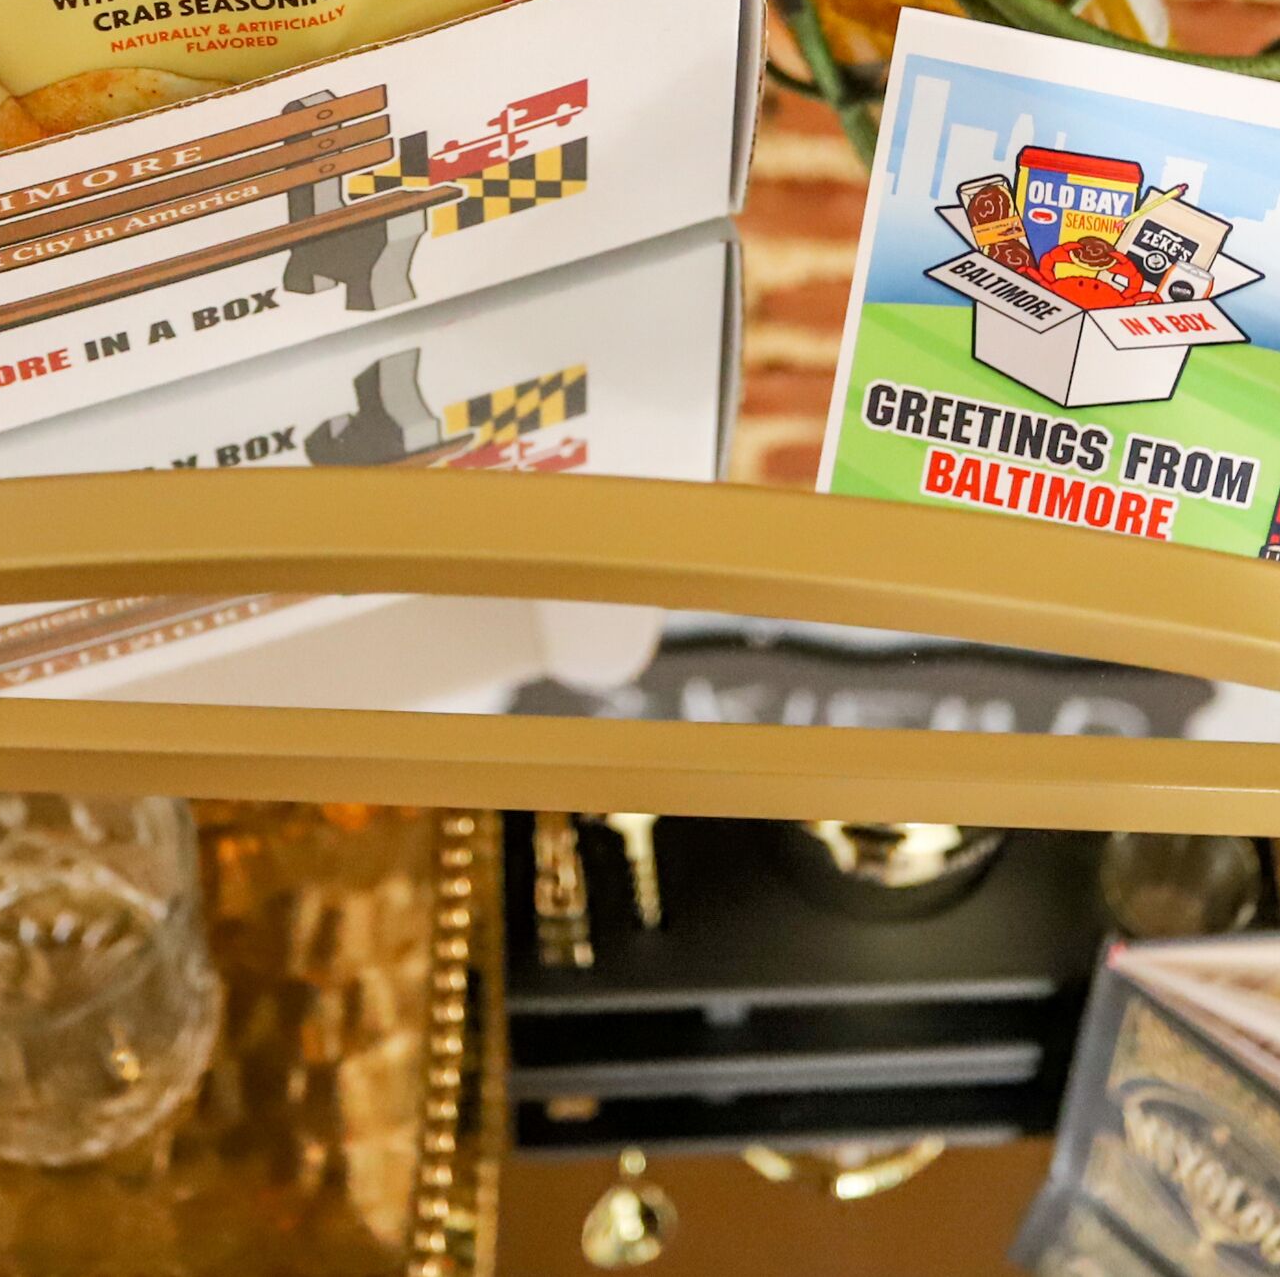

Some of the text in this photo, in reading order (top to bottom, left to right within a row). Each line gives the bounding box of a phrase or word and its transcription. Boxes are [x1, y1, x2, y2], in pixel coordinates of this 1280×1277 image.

[92, 2, 173, 32] CRAB
[110, 4, 346, 53] NATURALLY & ARTIFICIALLY
[186, 35, 278, 53] FLAVORED
[12, 235, 76, 262] City
[83, 223, 115, 242] in
[124, 184, 260, 232] America
[1029, 181, 1129, 217] OLD BAY
[1141, 229, 1193, 262] ZEKE'S
[950, 259, 1061, 321] BALTIMORE
[84, 332, 130, 362] IN
[148, 321, 175, 344] A
[193, 288, 280, 331] BOX
[1120, 312, 1217, 337] IN A BOX
[865, 383, 1255, 504] GREETINGS FROM
[926, 450, 1174, 540] BALTIMORE
